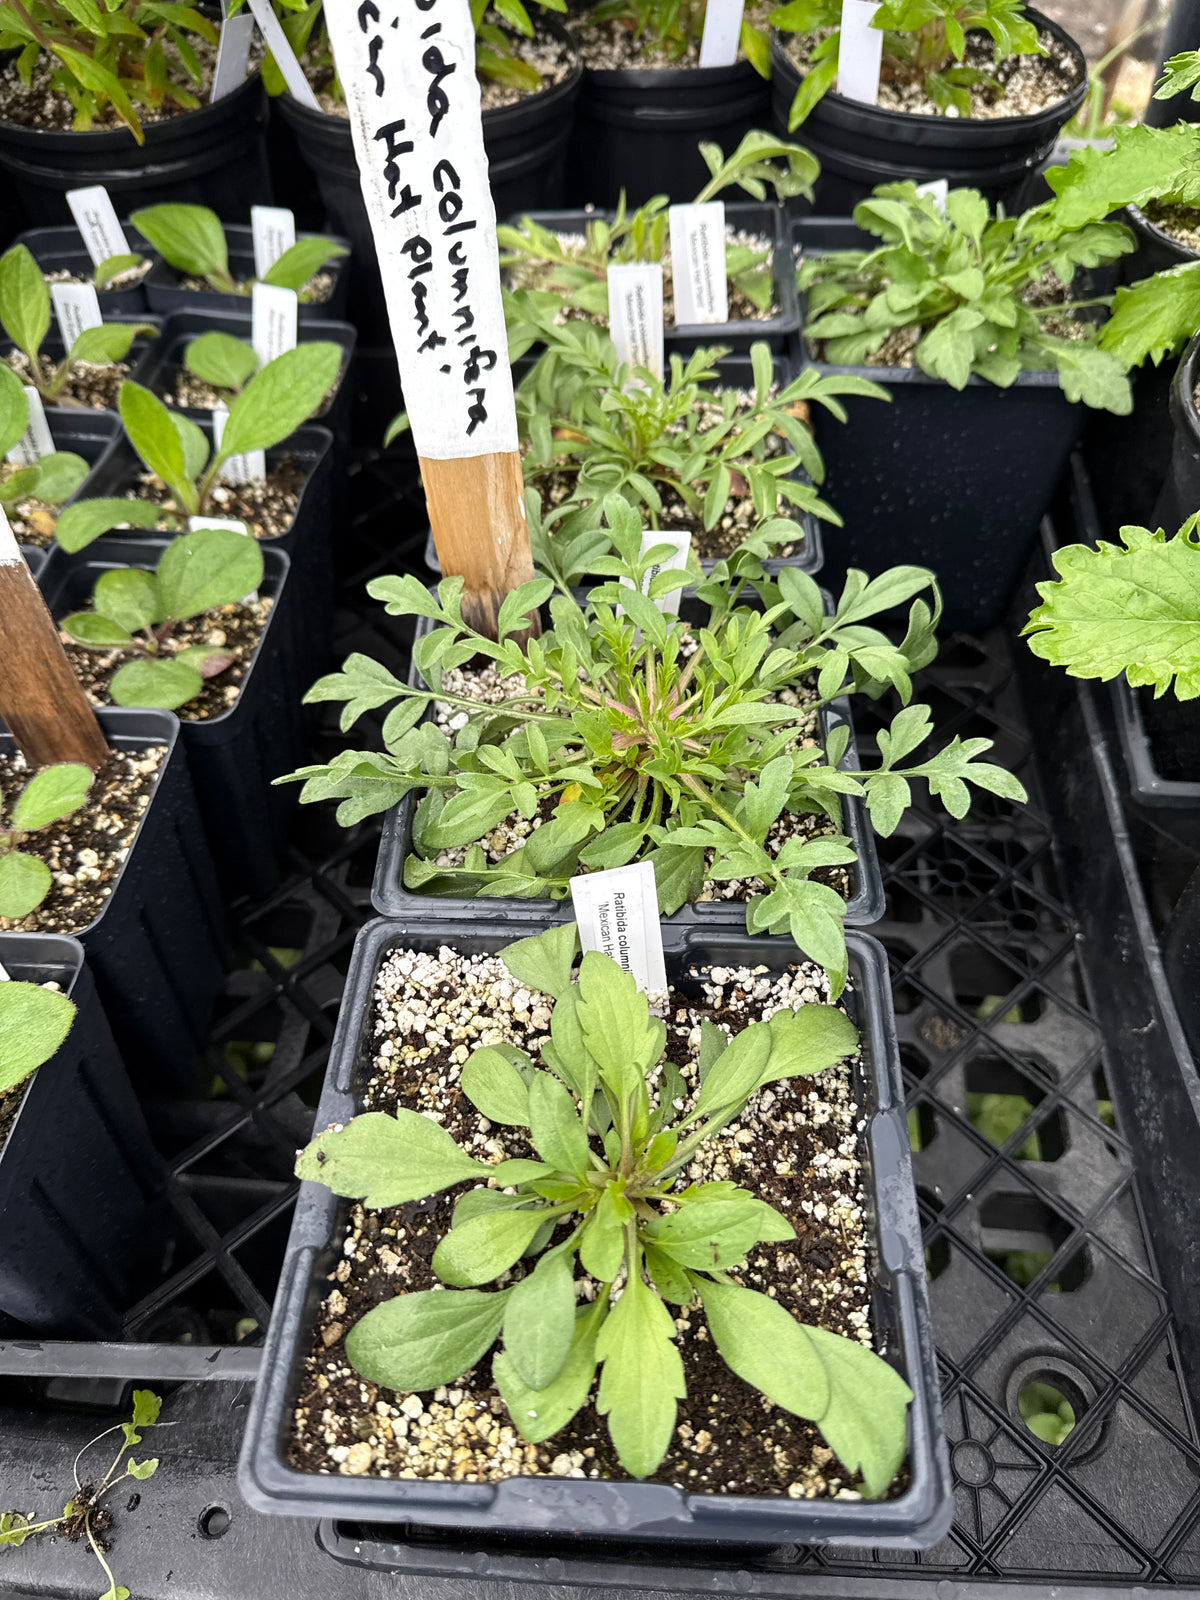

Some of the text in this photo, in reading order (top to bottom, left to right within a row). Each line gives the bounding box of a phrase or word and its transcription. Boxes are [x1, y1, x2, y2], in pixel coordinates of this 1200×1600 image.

[374, 118, 422, 219] Hat
[433, 159, 498, 437] columnifera
[597, 901, 611, 942] 'Mexican
[613, 892, 633, 975] Ratibida columni
